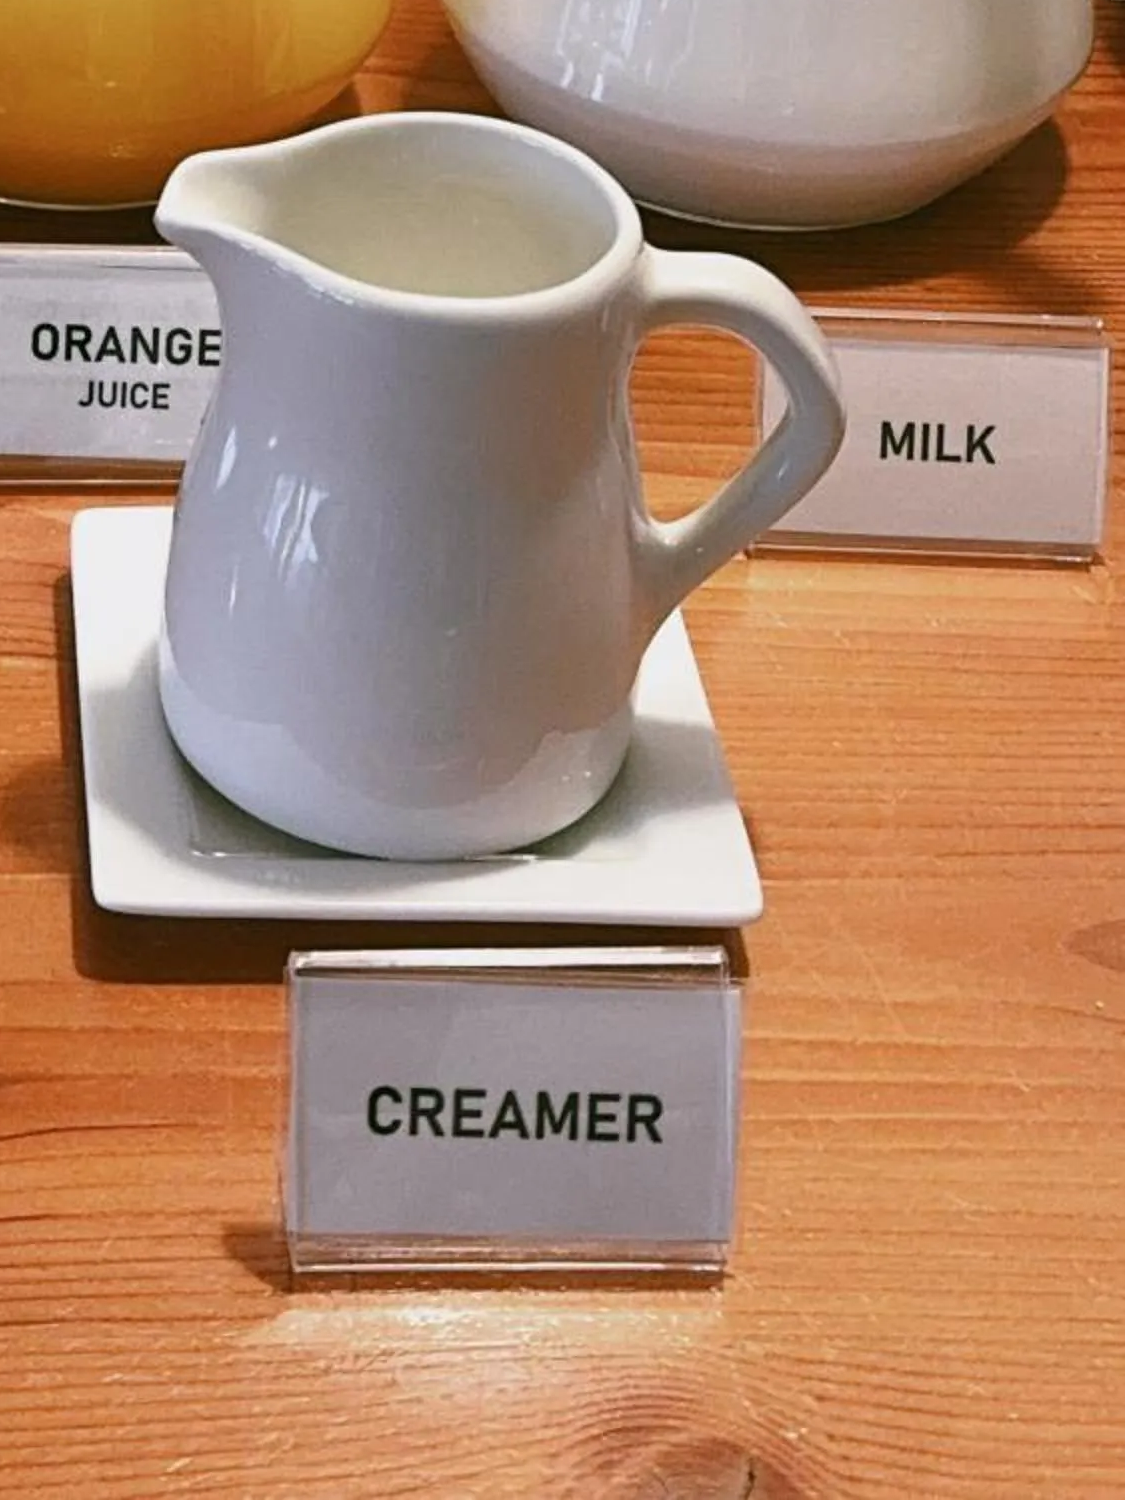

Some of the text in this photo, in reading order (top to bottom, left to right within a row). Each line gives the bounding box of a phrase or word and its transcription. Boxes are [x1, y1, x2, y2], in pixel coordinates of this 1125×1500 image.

[30, 322, 222, 367] ORANGE
[78, 379, 171, 410] JUICE
[879, 420, 996, 465] MILK
[366, 1084, 664, 1144] CREAMER
